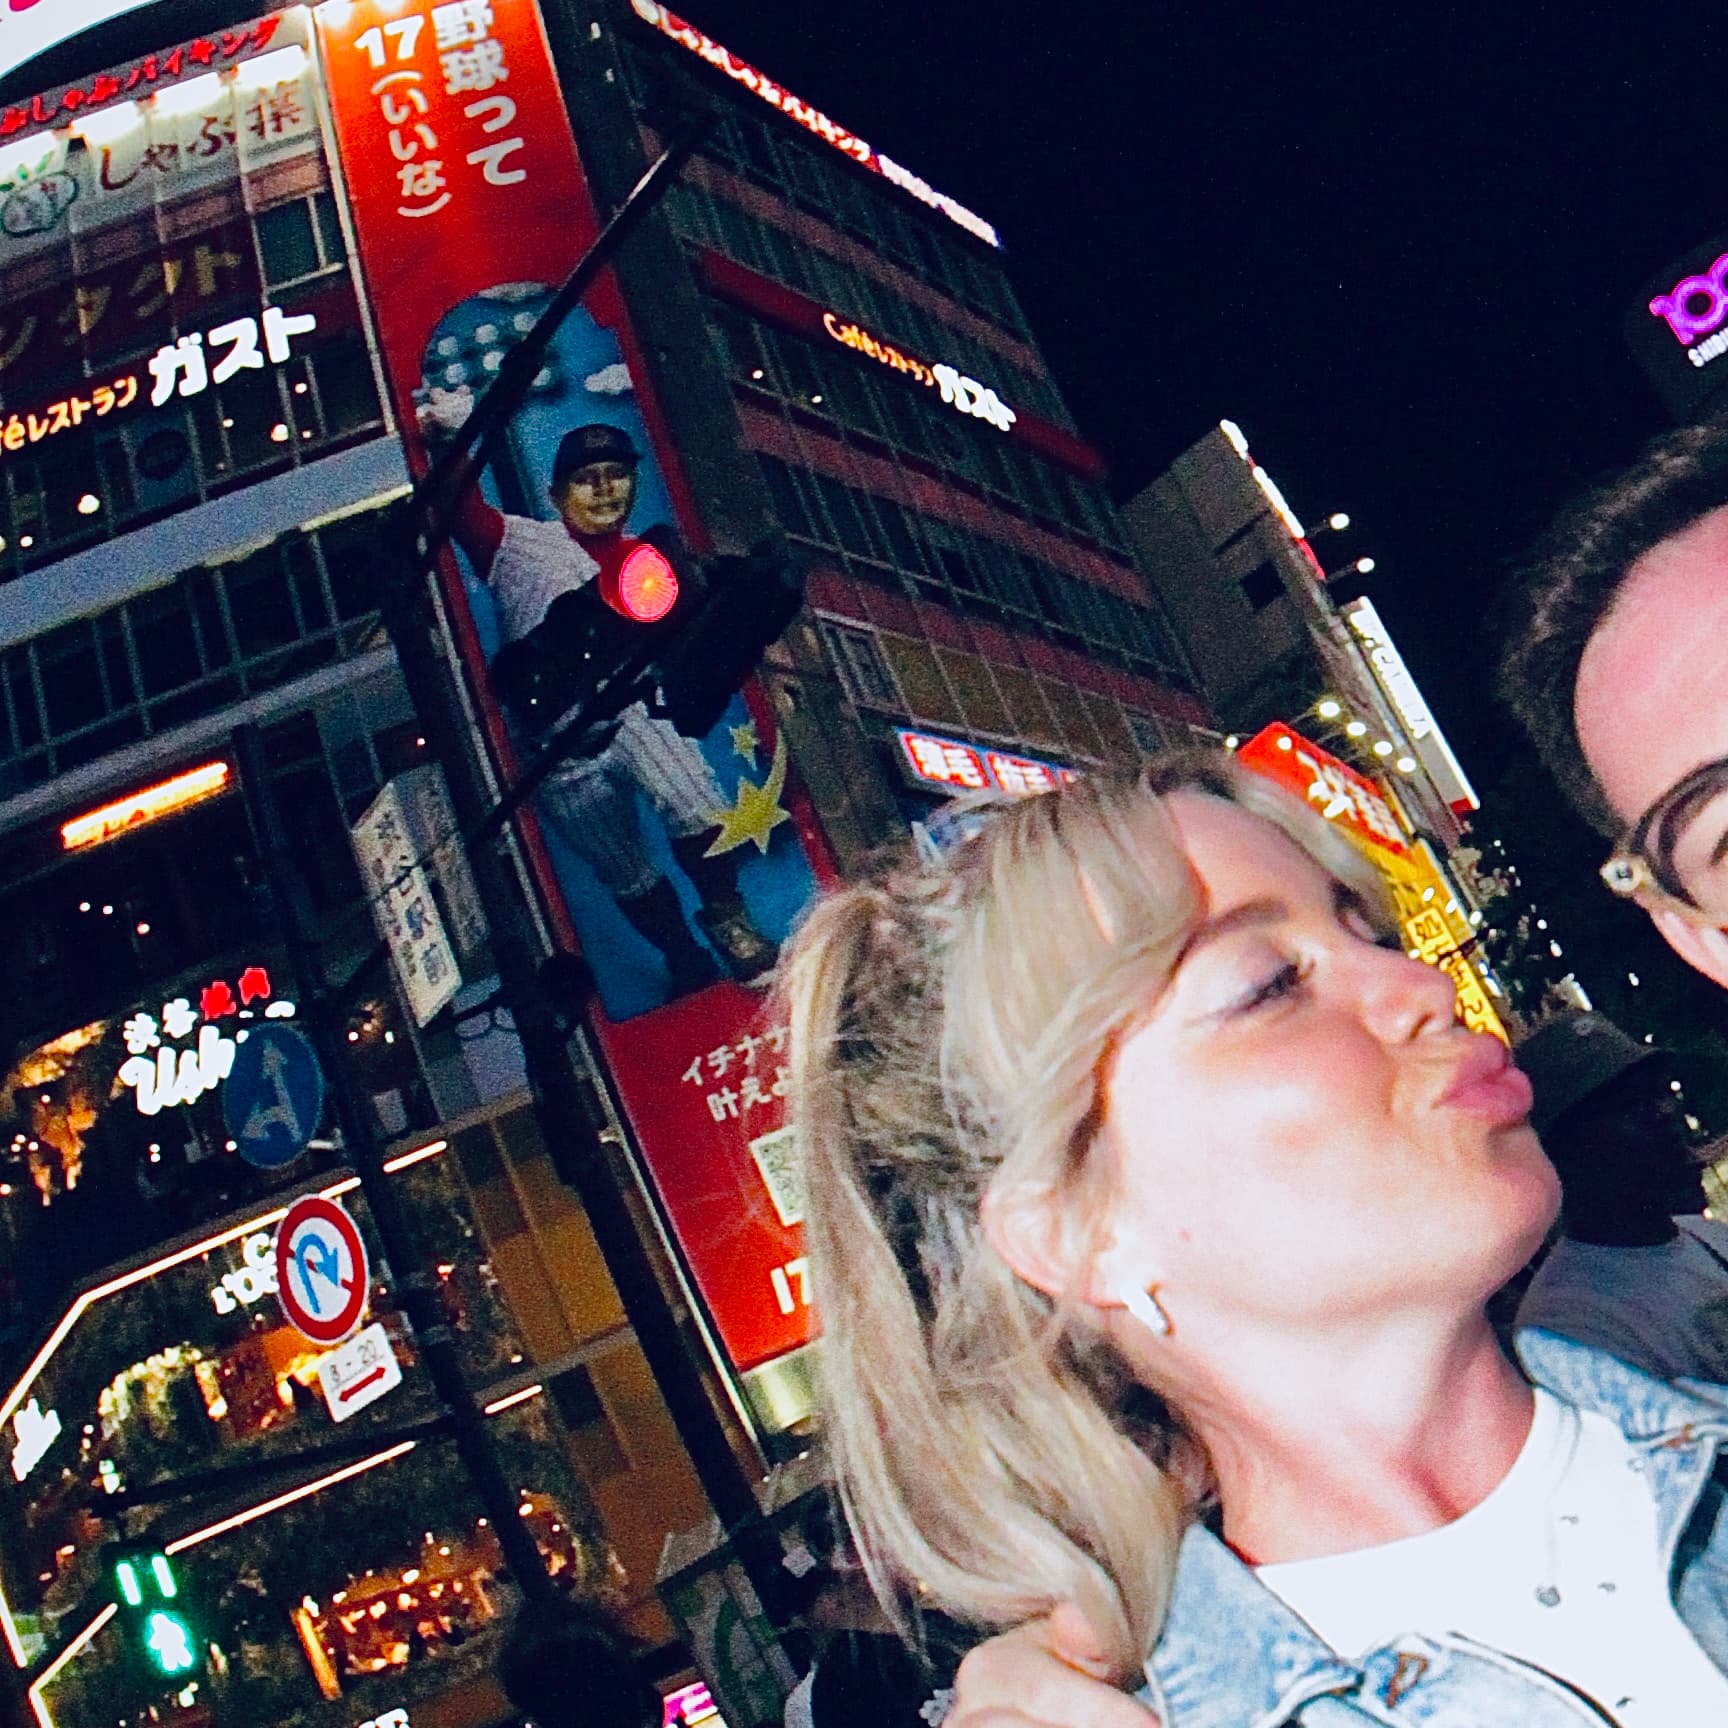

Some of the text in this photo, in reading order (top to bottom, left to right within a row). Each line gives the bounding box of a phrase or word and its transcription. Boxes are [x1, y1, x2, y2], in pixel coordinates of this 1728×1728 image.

[101, 83, 304, 189] しゃぶ葉
[148, 306, 317, 408] ガスト
